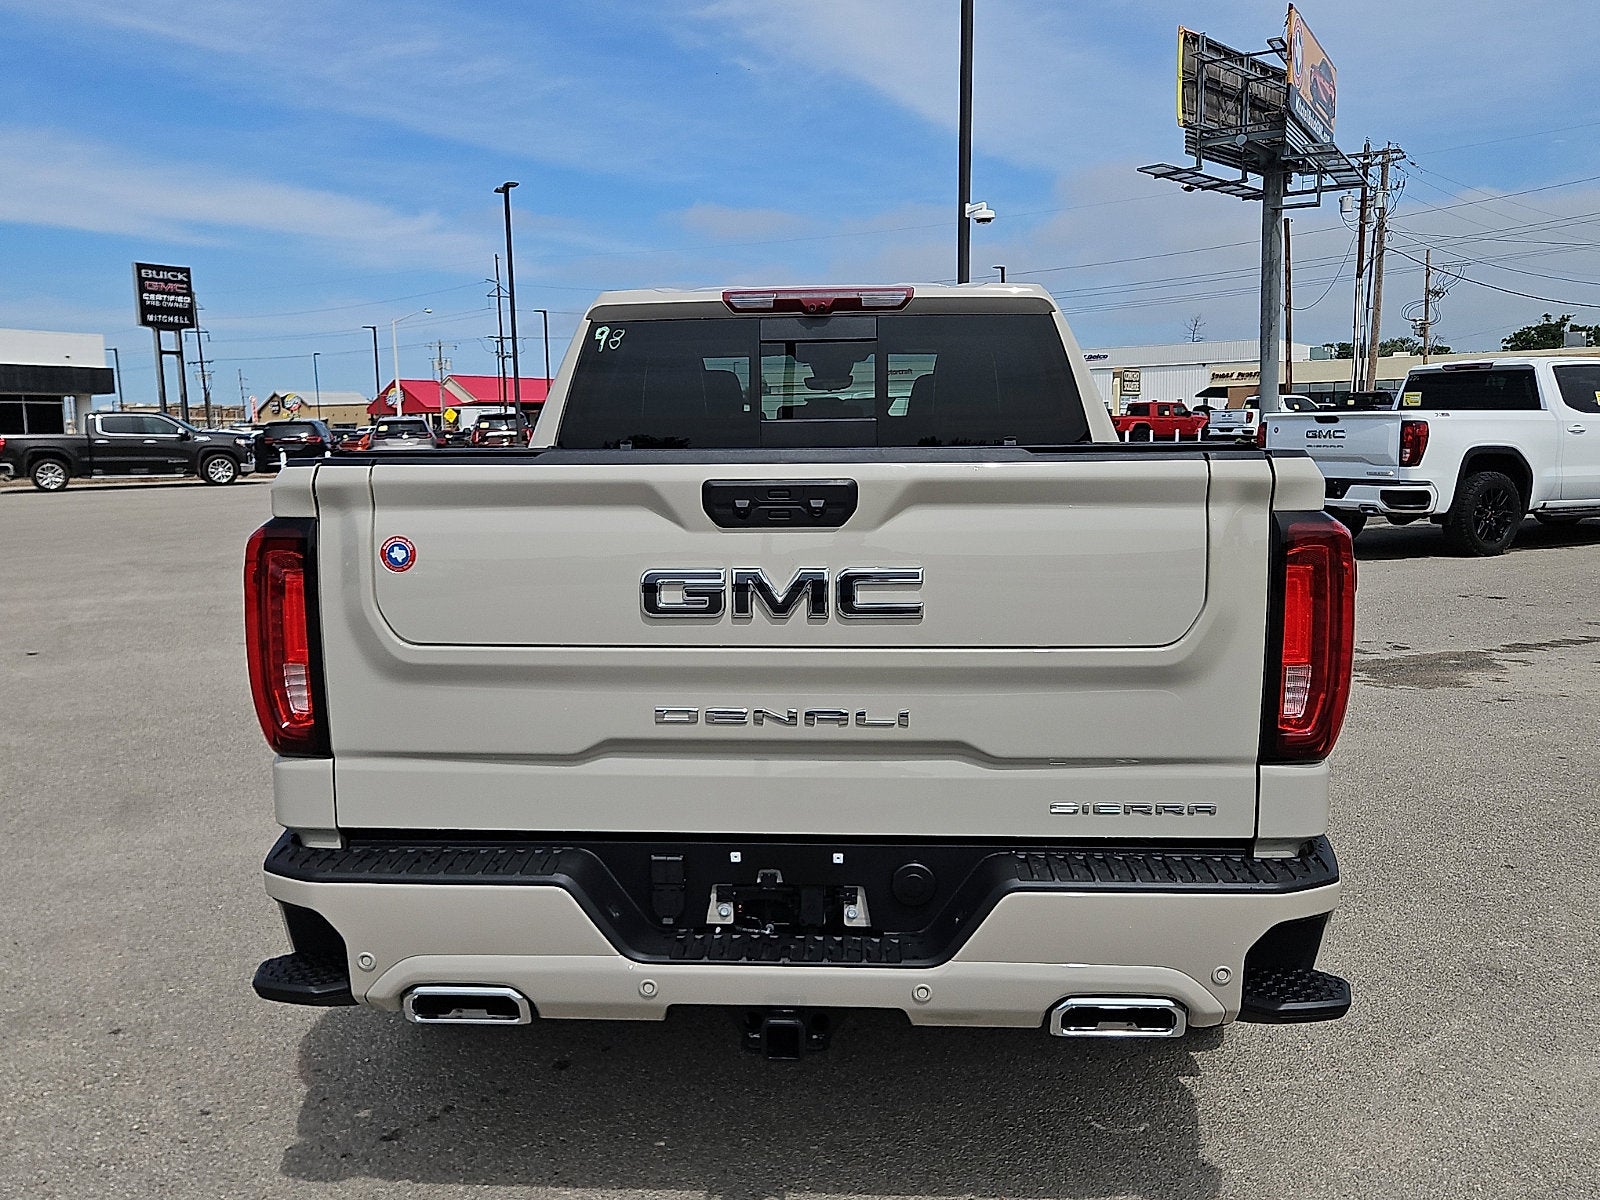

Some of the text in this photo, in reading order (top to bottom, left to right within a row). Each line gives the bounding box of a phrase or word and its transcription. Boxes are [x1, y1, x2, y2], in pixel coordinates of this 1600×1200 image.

[141, 269, 188, 281] BUICK
[144, 281, 187, 293] GMC
[142, 293, 191, 303] CERTIFIED
[146, 314, 190, 324] MITCHELL
[595, 326, 625, 352] 98
[1306, 429, 1346, 439] GMC
[641, 567, 924, 619] GMC
[654, 706, 910, 728] DENALI
[1050, 801, 1217, 816] SIERRA
